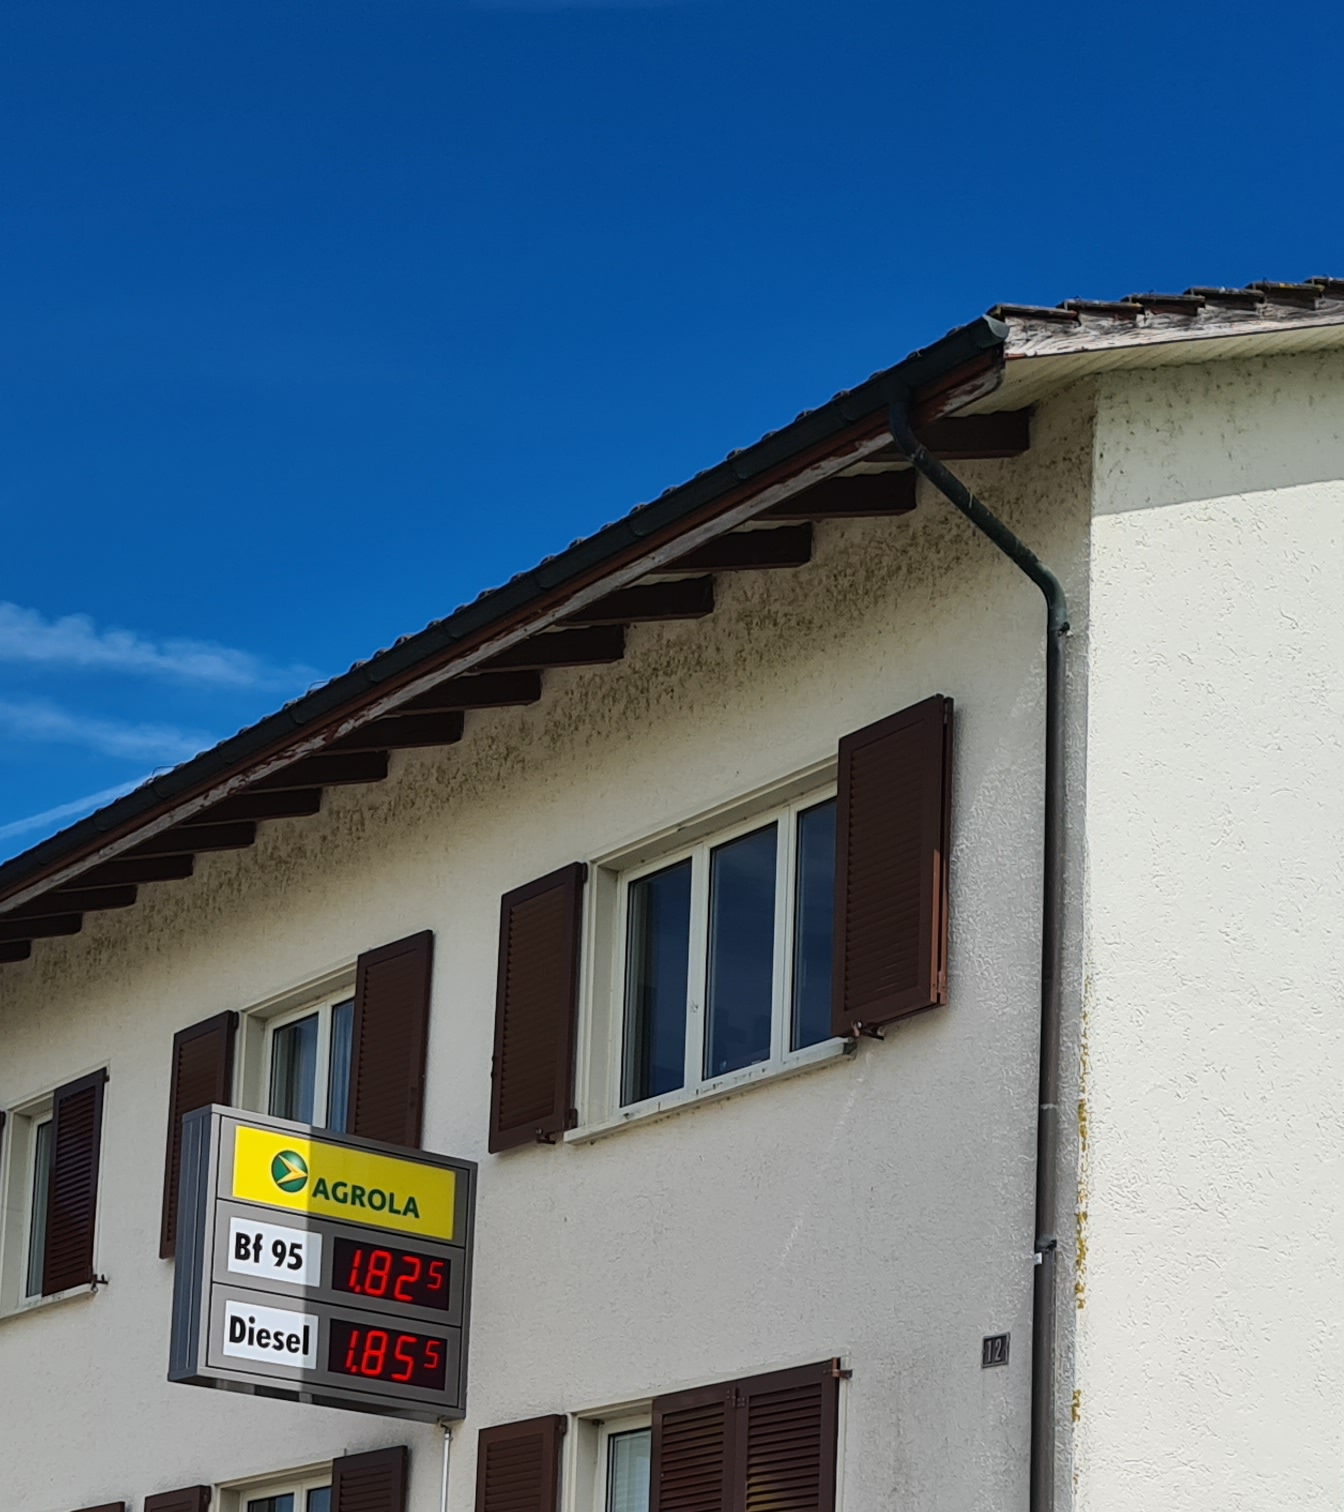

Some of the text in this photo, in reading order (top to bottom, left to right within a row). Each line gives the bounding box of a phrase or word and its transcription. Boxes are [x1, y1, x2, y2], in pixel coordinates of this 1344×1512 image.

[312, 1178, 420, 1219] AGROLA
[234, 1232, 304, 1270] Bf 95
[228, 1315, 310, 1356] Diesel
[987, 1338, 1002, 1363] 12
